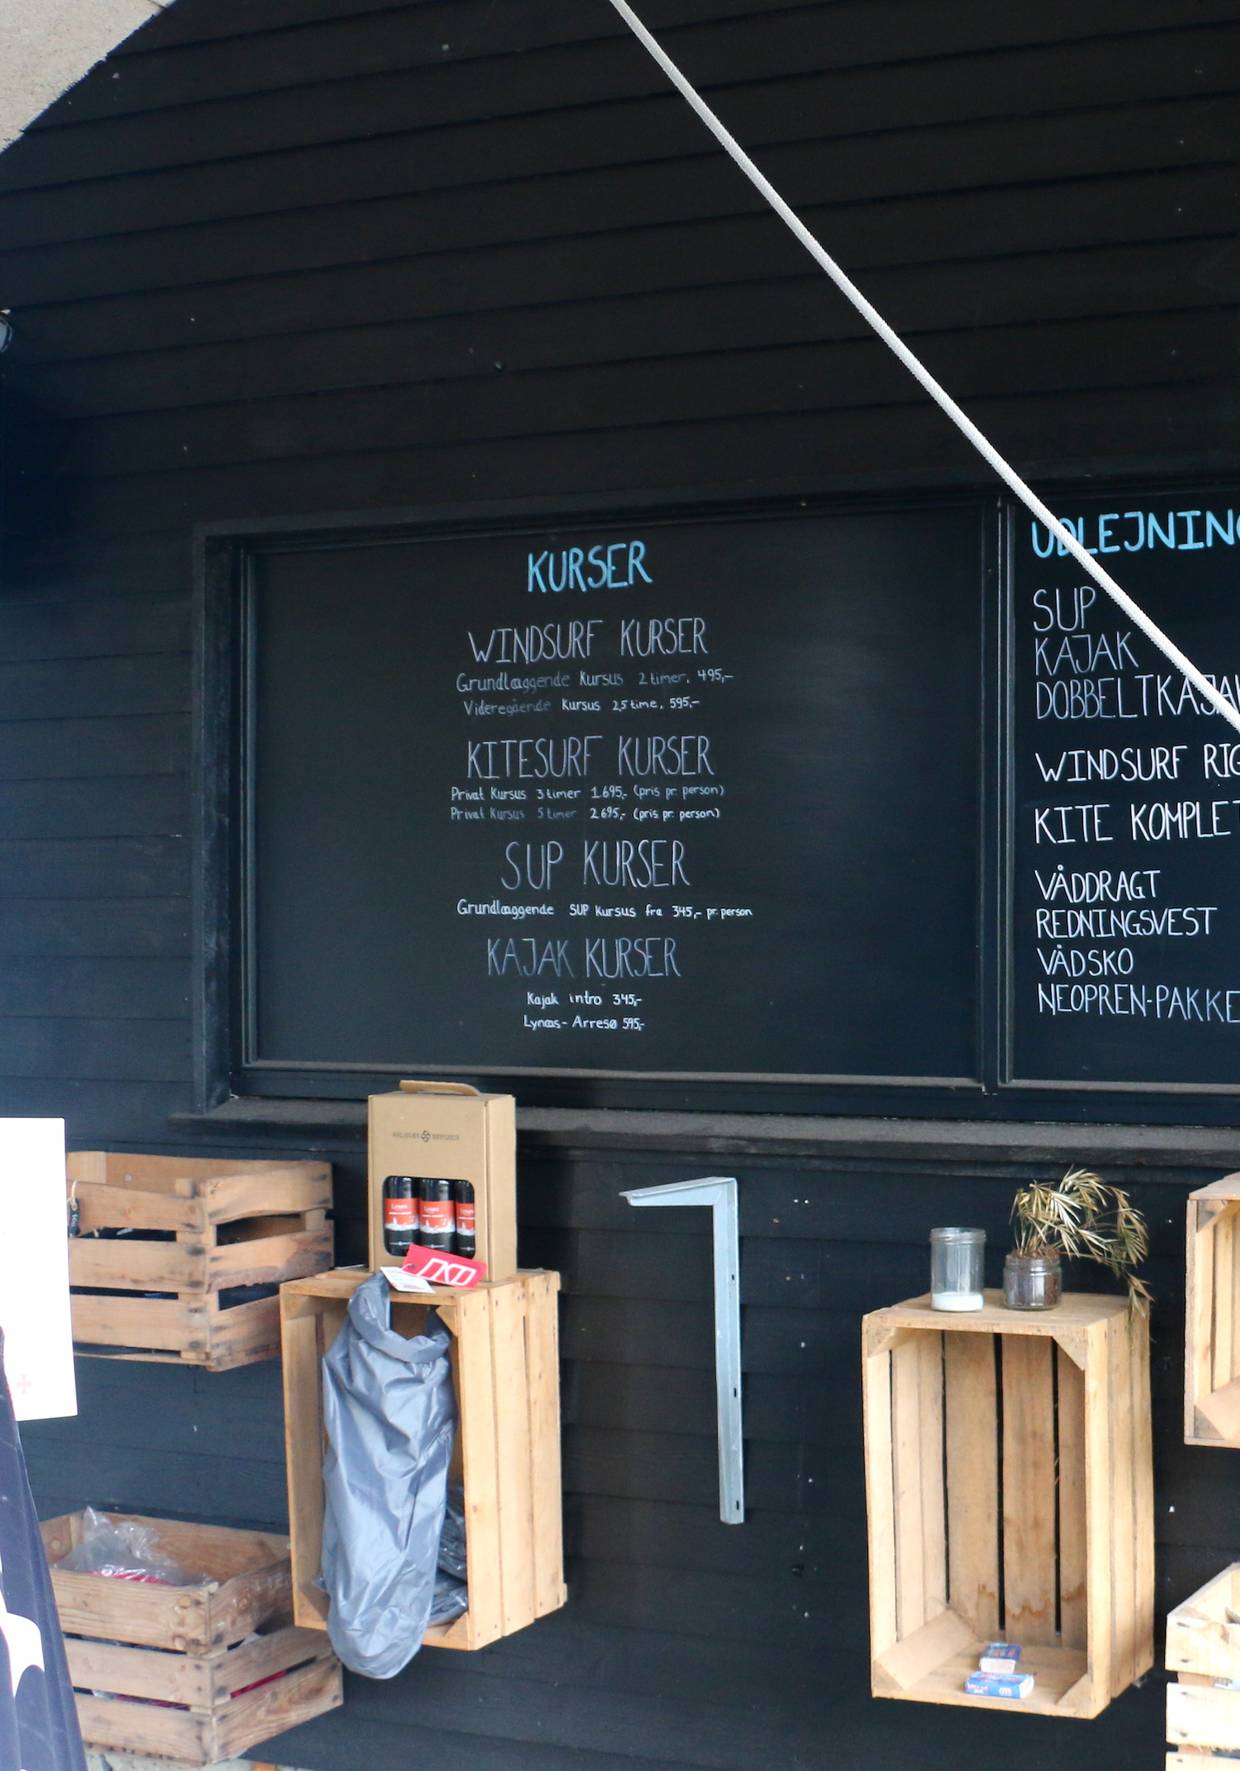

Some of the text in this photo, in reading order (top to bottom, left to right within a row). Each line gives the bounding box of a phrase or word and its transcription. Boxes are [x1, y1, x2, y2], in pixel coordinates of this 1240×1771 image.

[527, 540, 652, 593] KURSER
[1033, 585, 1096, 631] SUP
[467, 617, 708, 664] WINDSURF KURSER
[1035, 631, 1139, 676] KAJAK
[580, 671, 624, 686] Kursus
[561, 698, 601, 712] Kursus
[467, 735, 715, 779] KITESURF KURSER
[1035, 745, 1188, 782] WINDSURF
[490, 787, 527, 801] Kursus
[1035, 804, 1113, 843] KITE
[501, 839, 690, 890] SUP KURSER
[1035, 864, 1161, 903] VÅDDRAGT
[457, 899, 554, 920] Grundlæggende
[569, 903, 590, 917] SUP
[595, 904, 637, 918] Kursus
[645, 903, 663, 917] fra
[720, 908, 753, 921] person
[1036, 907, 1217, 938] REDNINGSVEST
[487, 937, 681, 978] KAJAK KURSER
[1037, 944, 1134, 977] VÅDSKO
[527, 991, 559, 1009] Kajak
[569, 989, 603, 1006] intro
